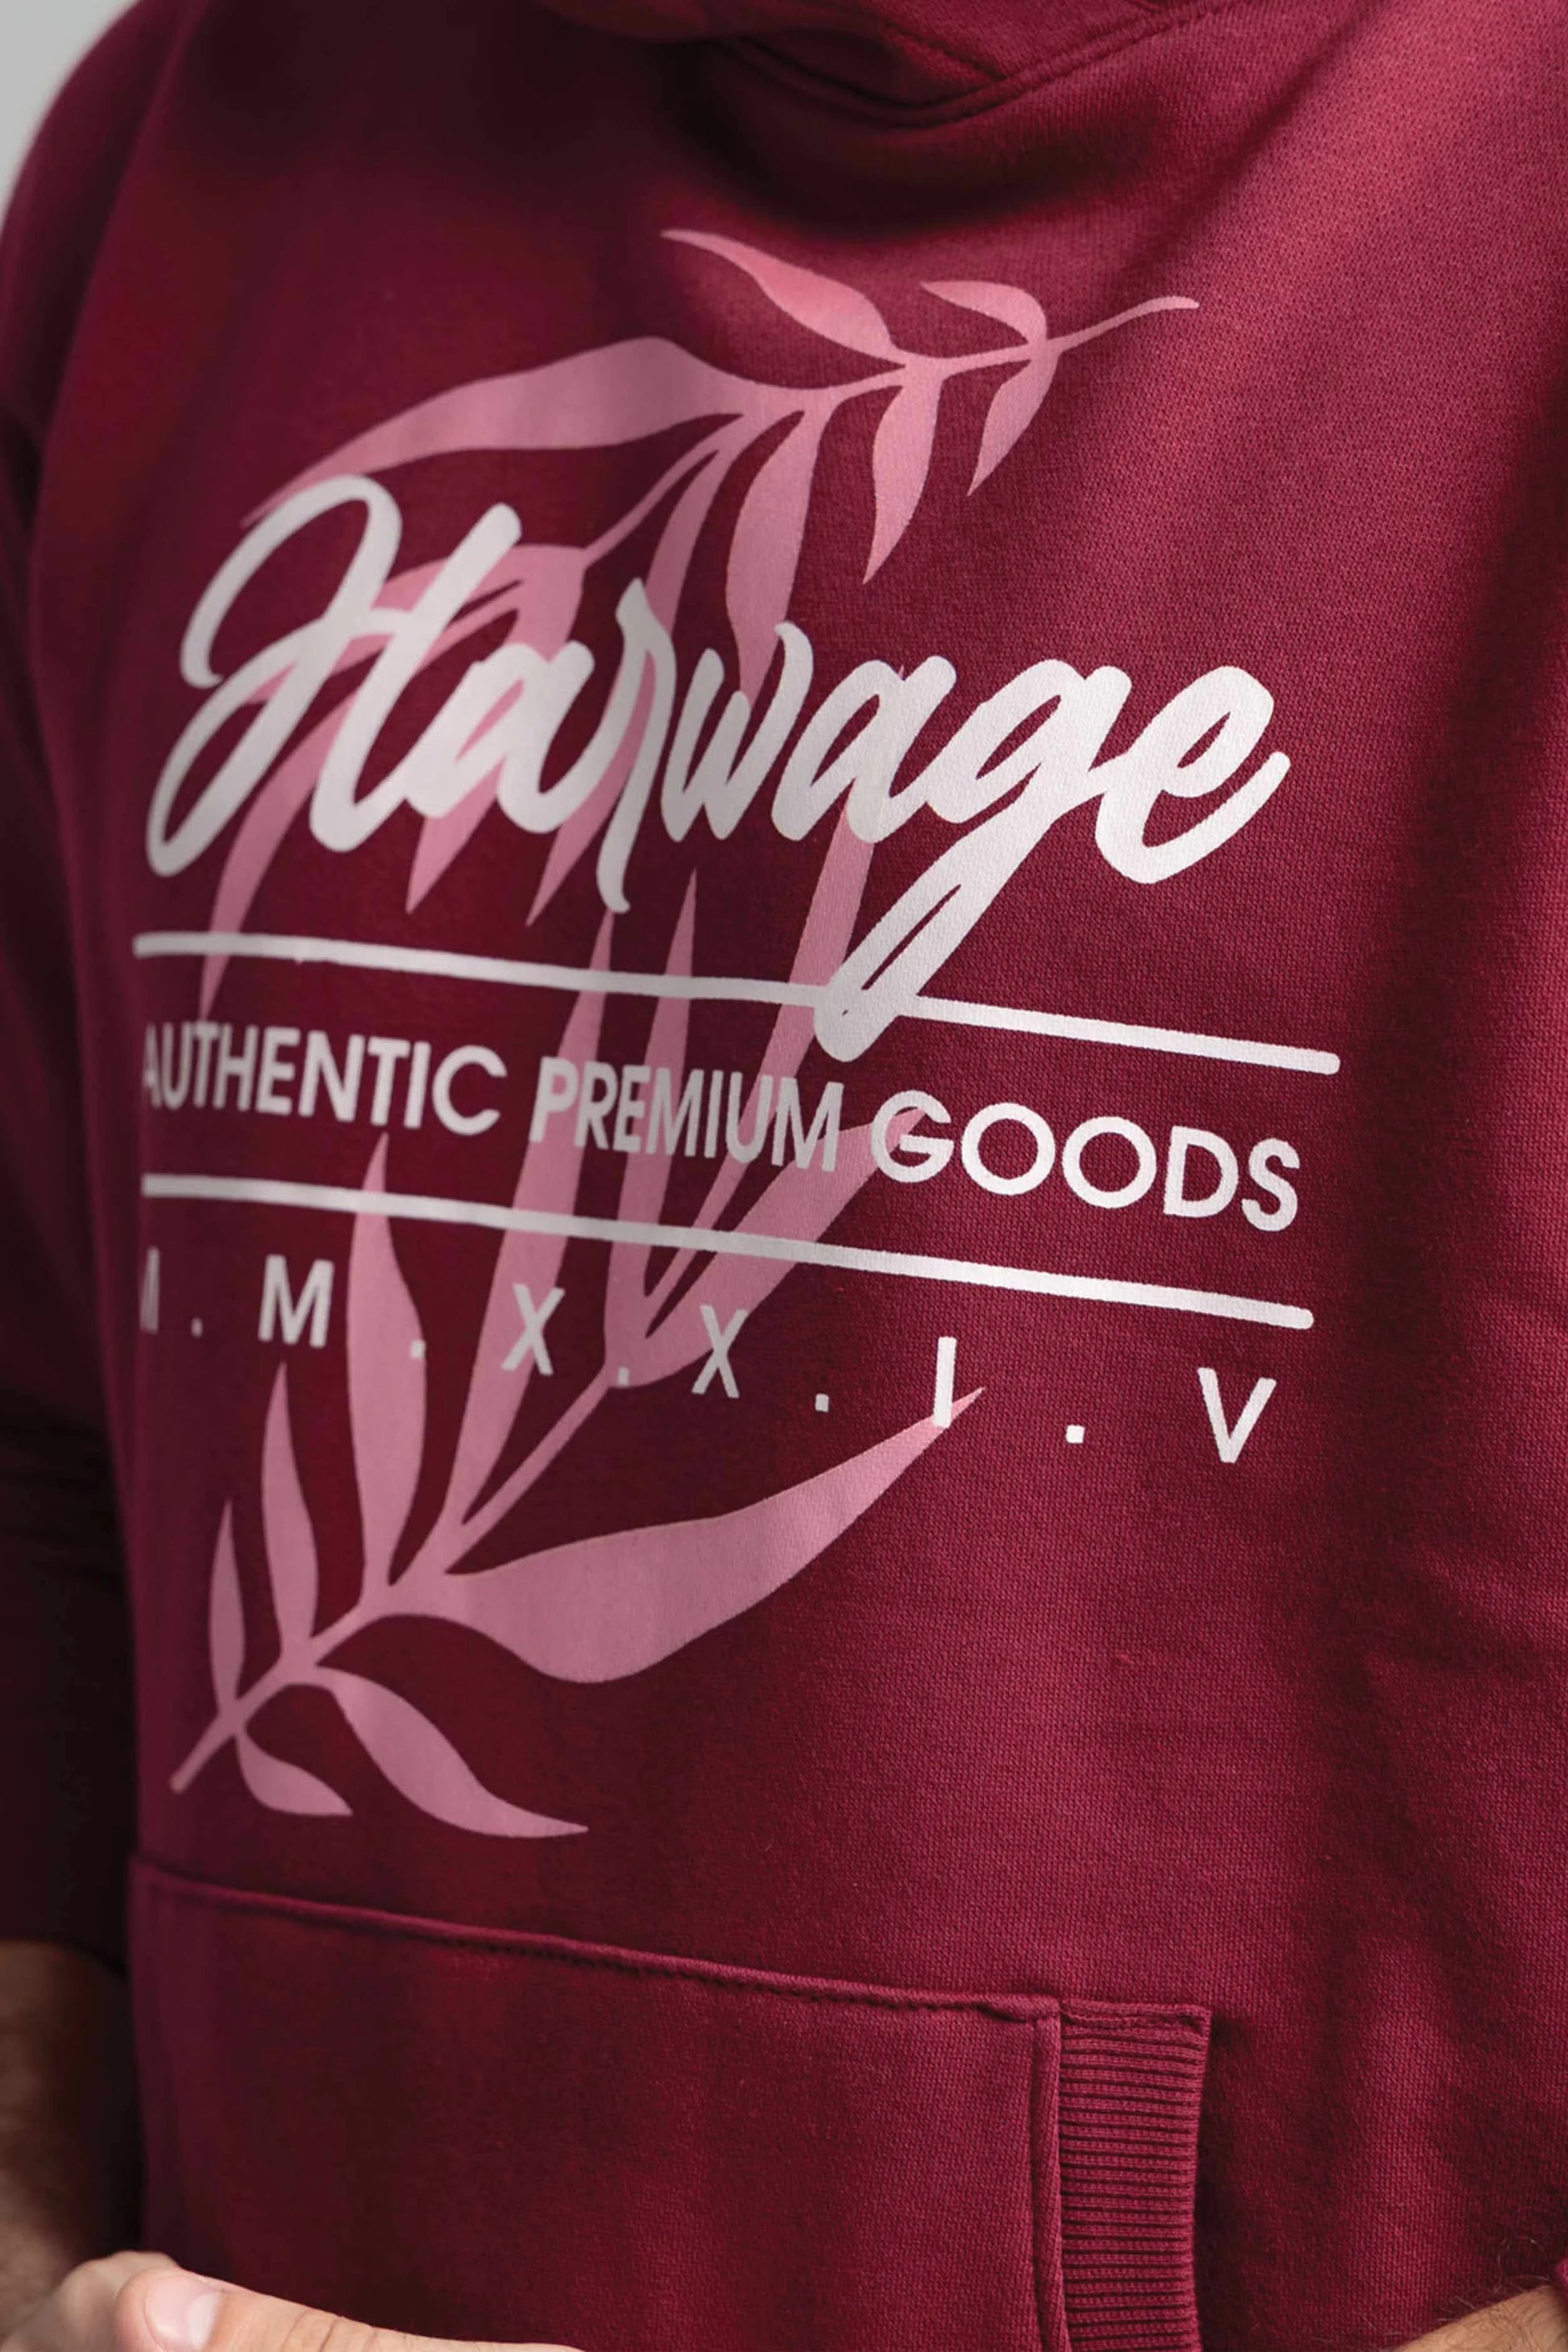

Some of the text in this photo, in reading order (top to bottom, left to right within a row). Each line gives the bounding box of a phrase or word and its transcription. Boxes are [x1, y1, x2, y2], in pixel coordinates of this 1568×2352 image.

[142, 1021, 1300, 1232] AUTHENTIC PREMIUM GOODS
